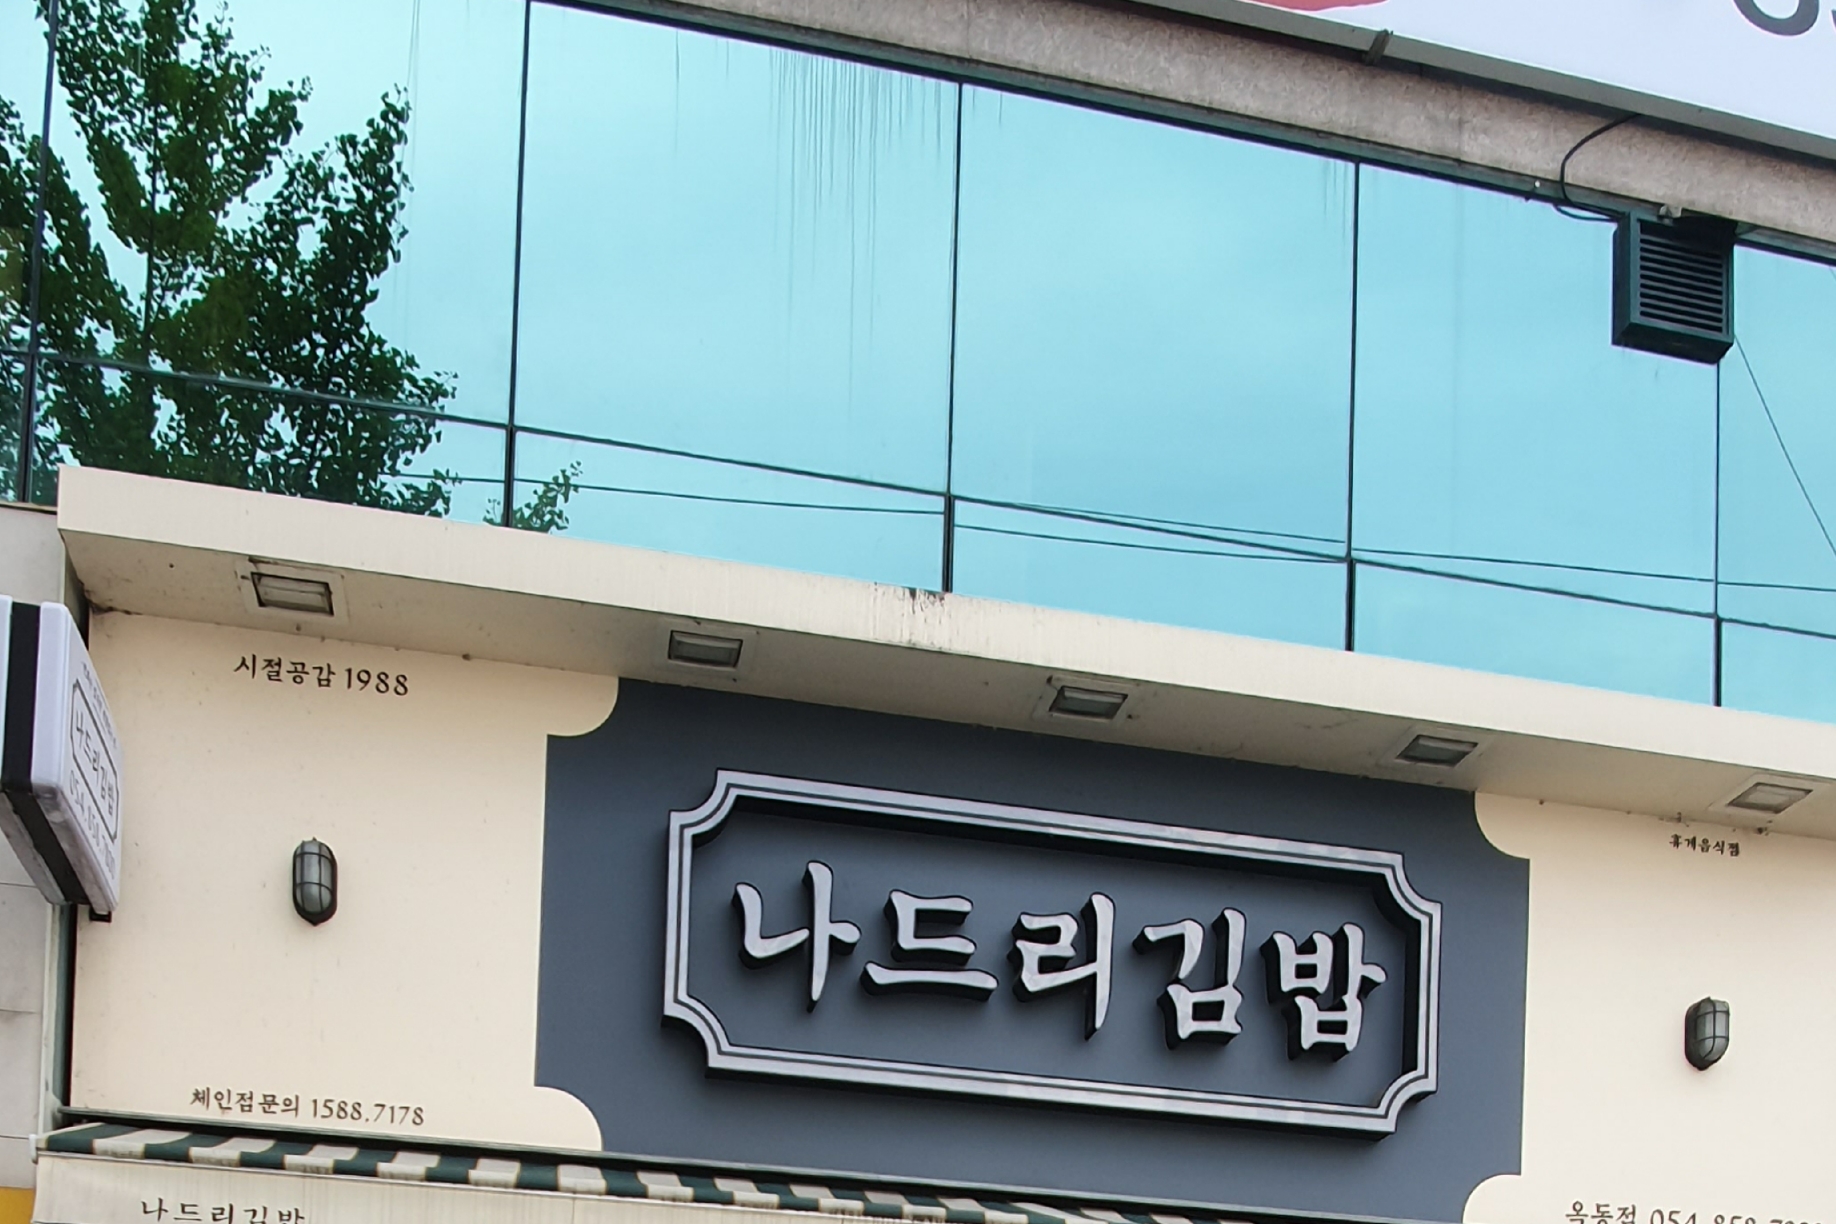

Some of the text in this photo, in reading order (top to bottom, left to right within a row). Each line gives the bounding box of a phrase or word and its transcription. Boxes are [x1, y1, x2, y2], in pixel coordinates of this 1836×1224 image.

[233, 654, 410, 697] 시절공감 1988
[1668, 833, 1741, 857] 휴게음식점
[732, 859, 1388, 1061] 나드리김밥
[310, 1097, 425, 1126] 1588.7178
